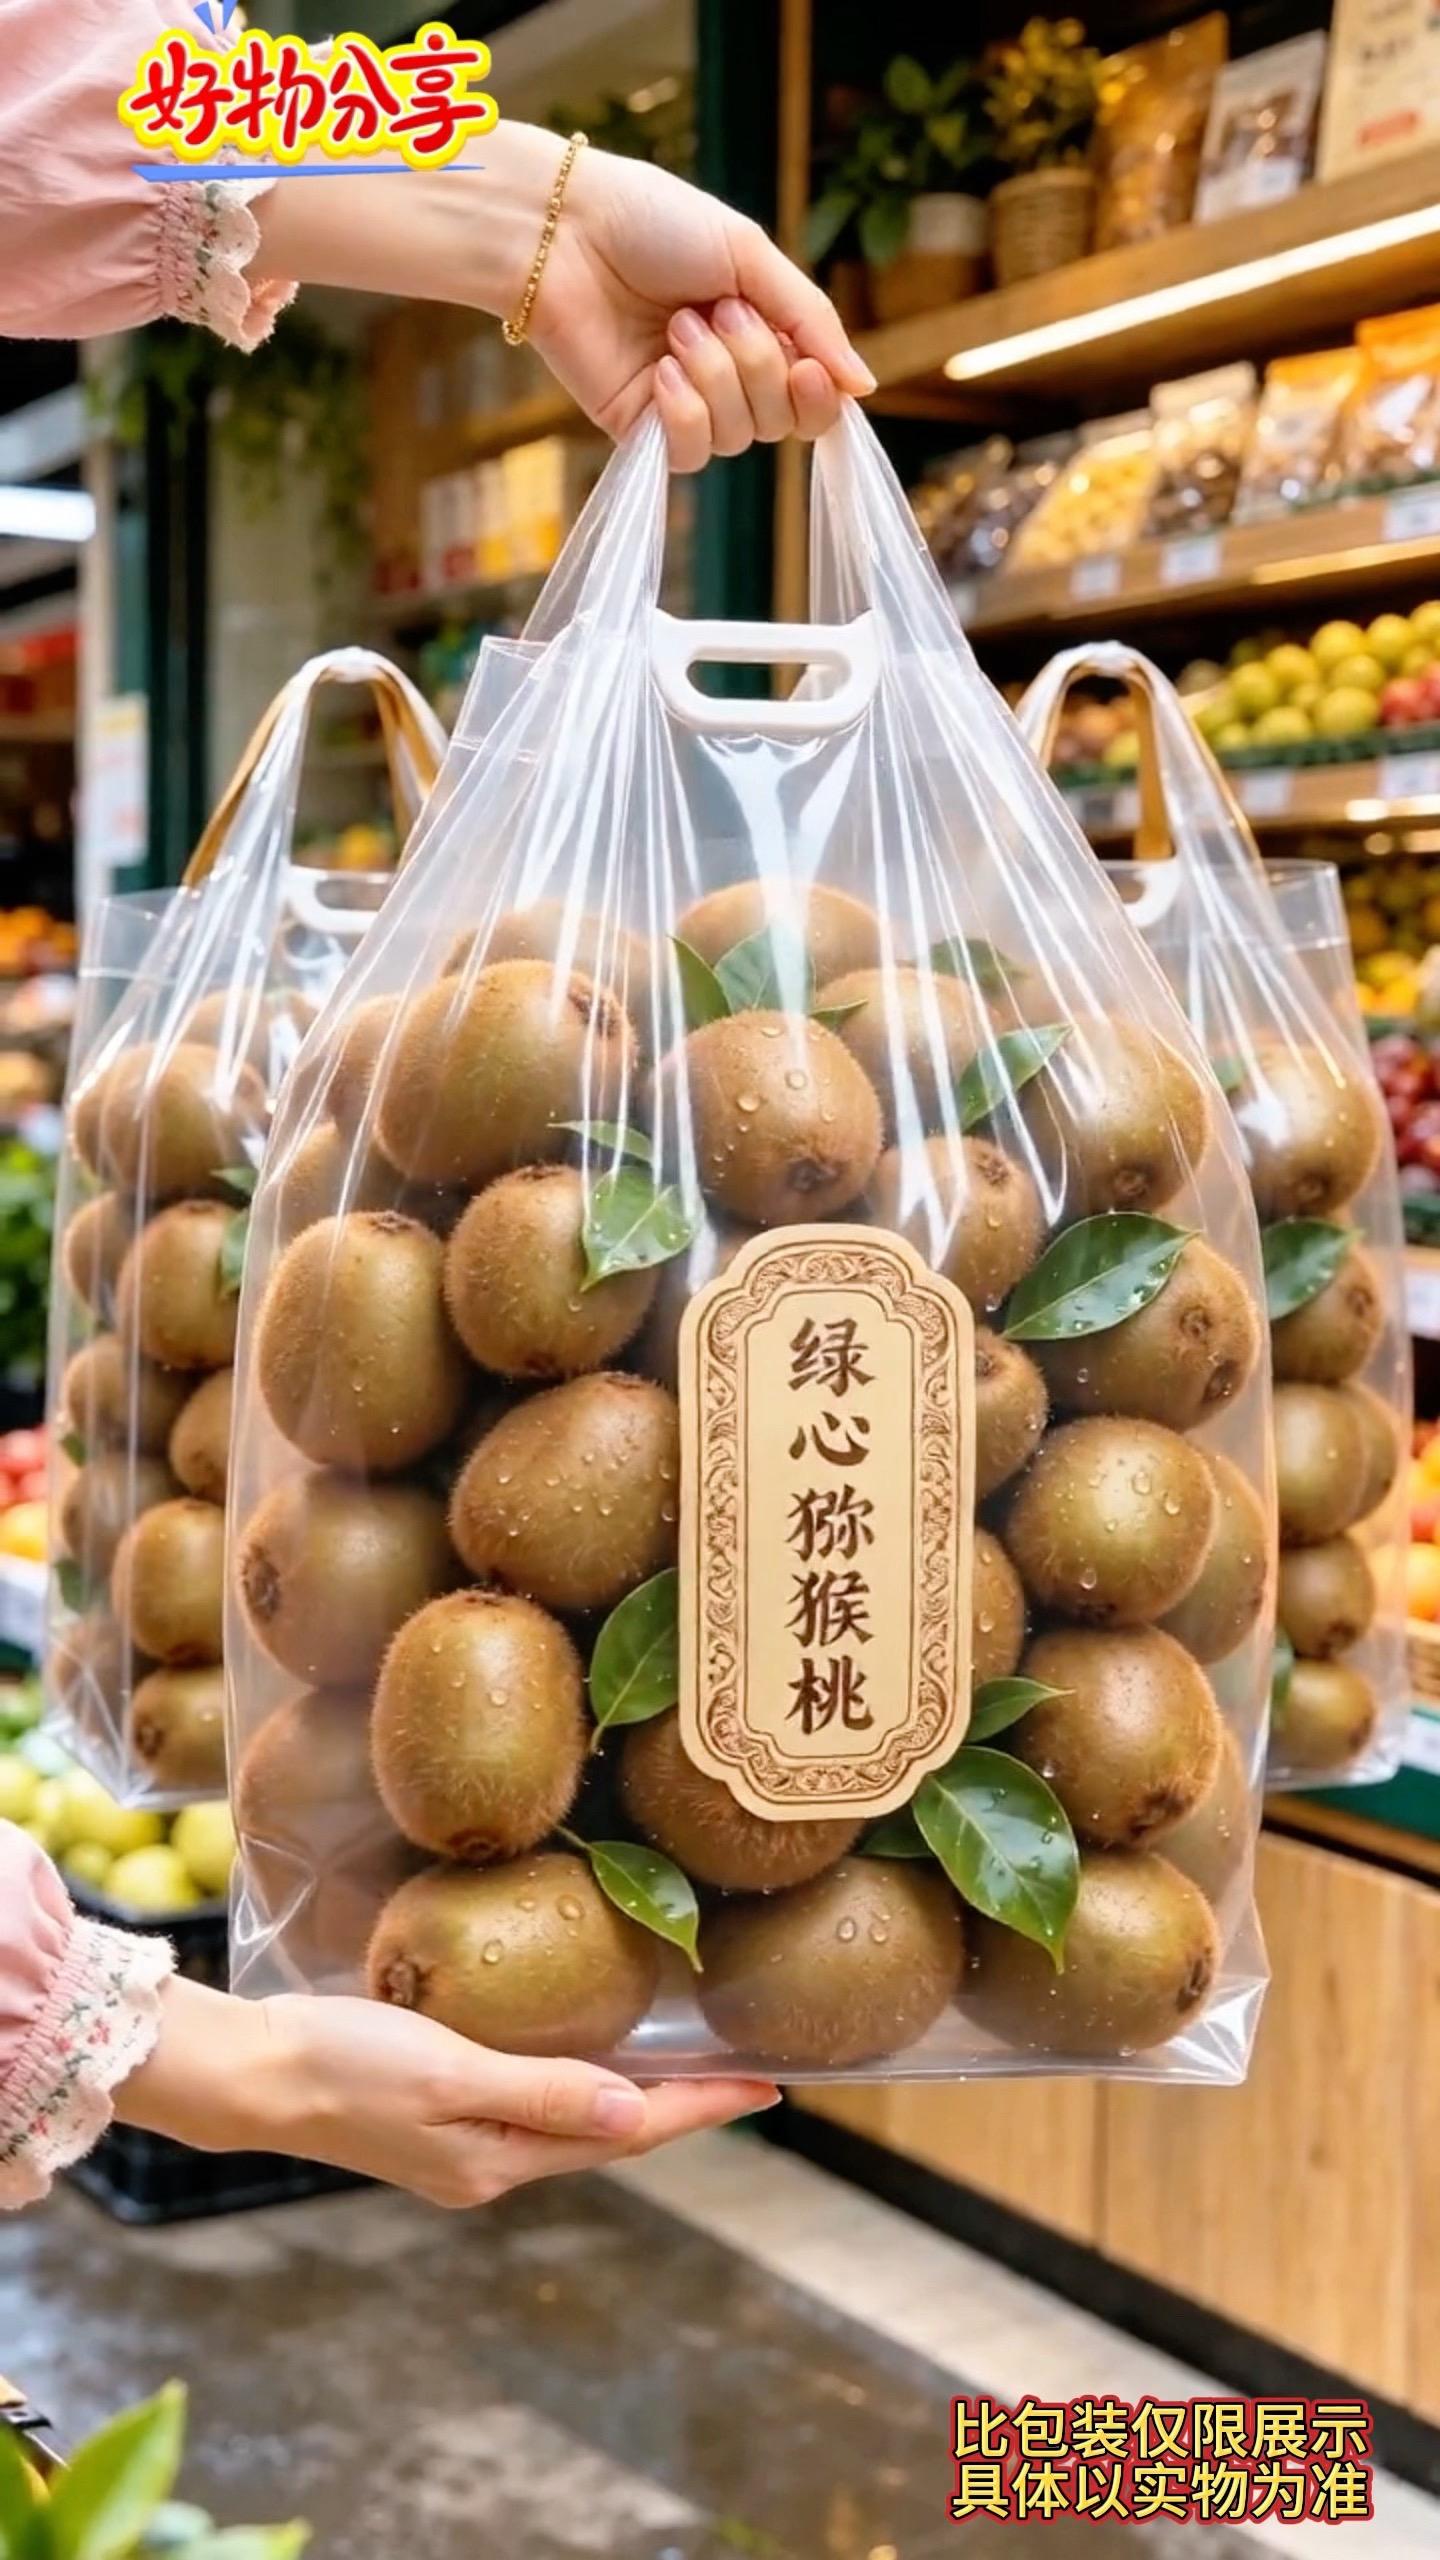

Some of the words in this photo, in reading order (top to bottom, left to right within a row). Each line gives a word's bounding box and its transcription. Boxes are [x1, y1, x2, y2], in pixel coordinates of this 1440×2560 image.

[786, 1317, 875, 1735] 绿心猕猴桃
